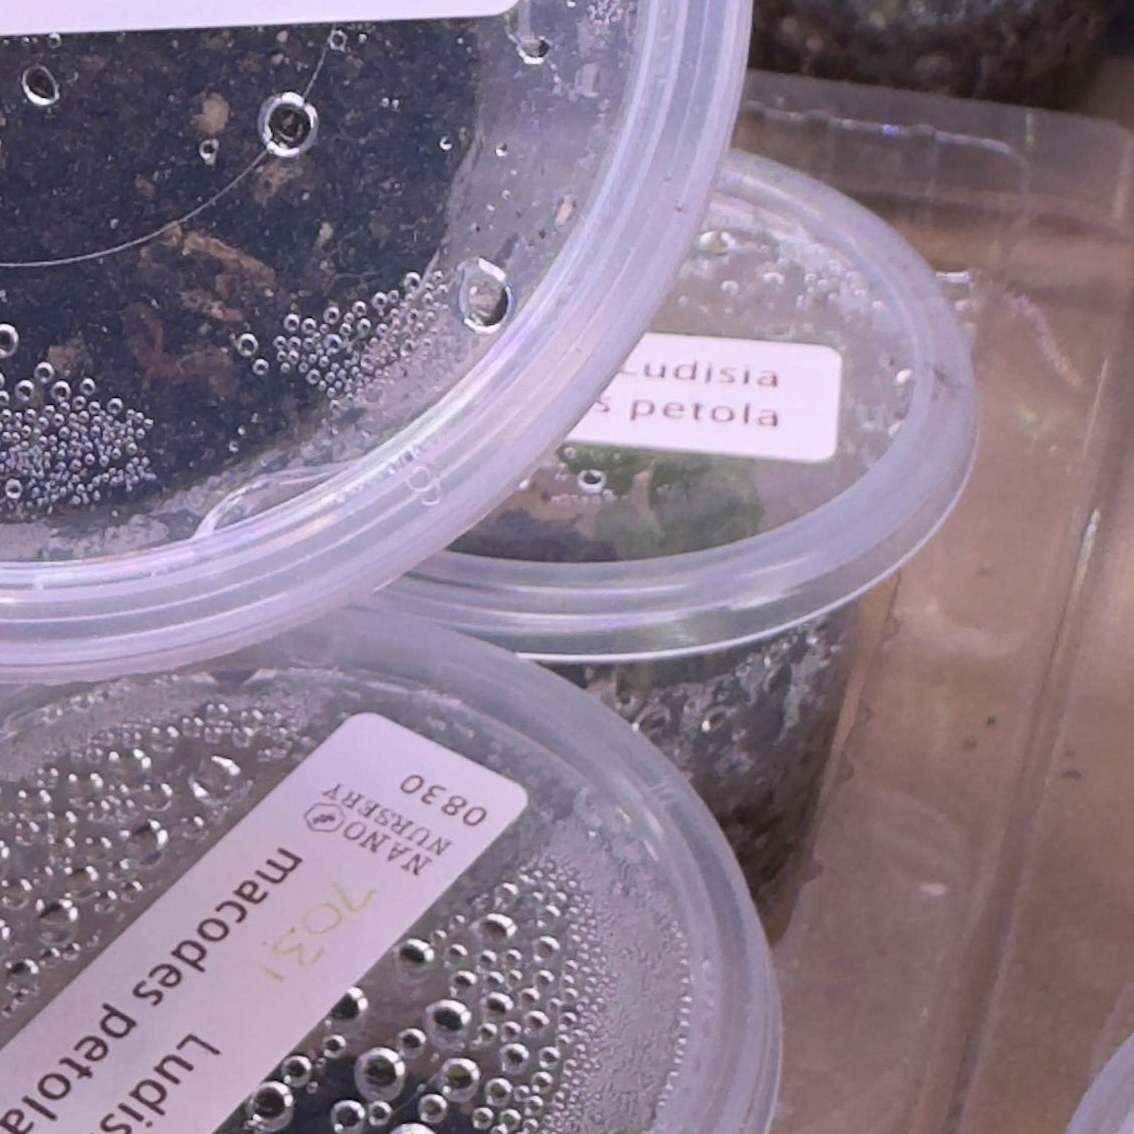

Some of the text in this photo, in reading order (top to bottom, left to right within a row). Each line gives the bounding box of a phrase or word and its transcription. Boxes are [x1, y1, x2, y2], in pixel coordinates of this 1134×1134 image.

[629, 399, 779, 428] petola
[321, 783, 452, 857] NURSERY
[399, 774, 488, 828] 0830
[342, 821, 433, 877] NANO
[133, 847, 304, 1008] macodes
[91, 1032, 222, 1134] Ludis
